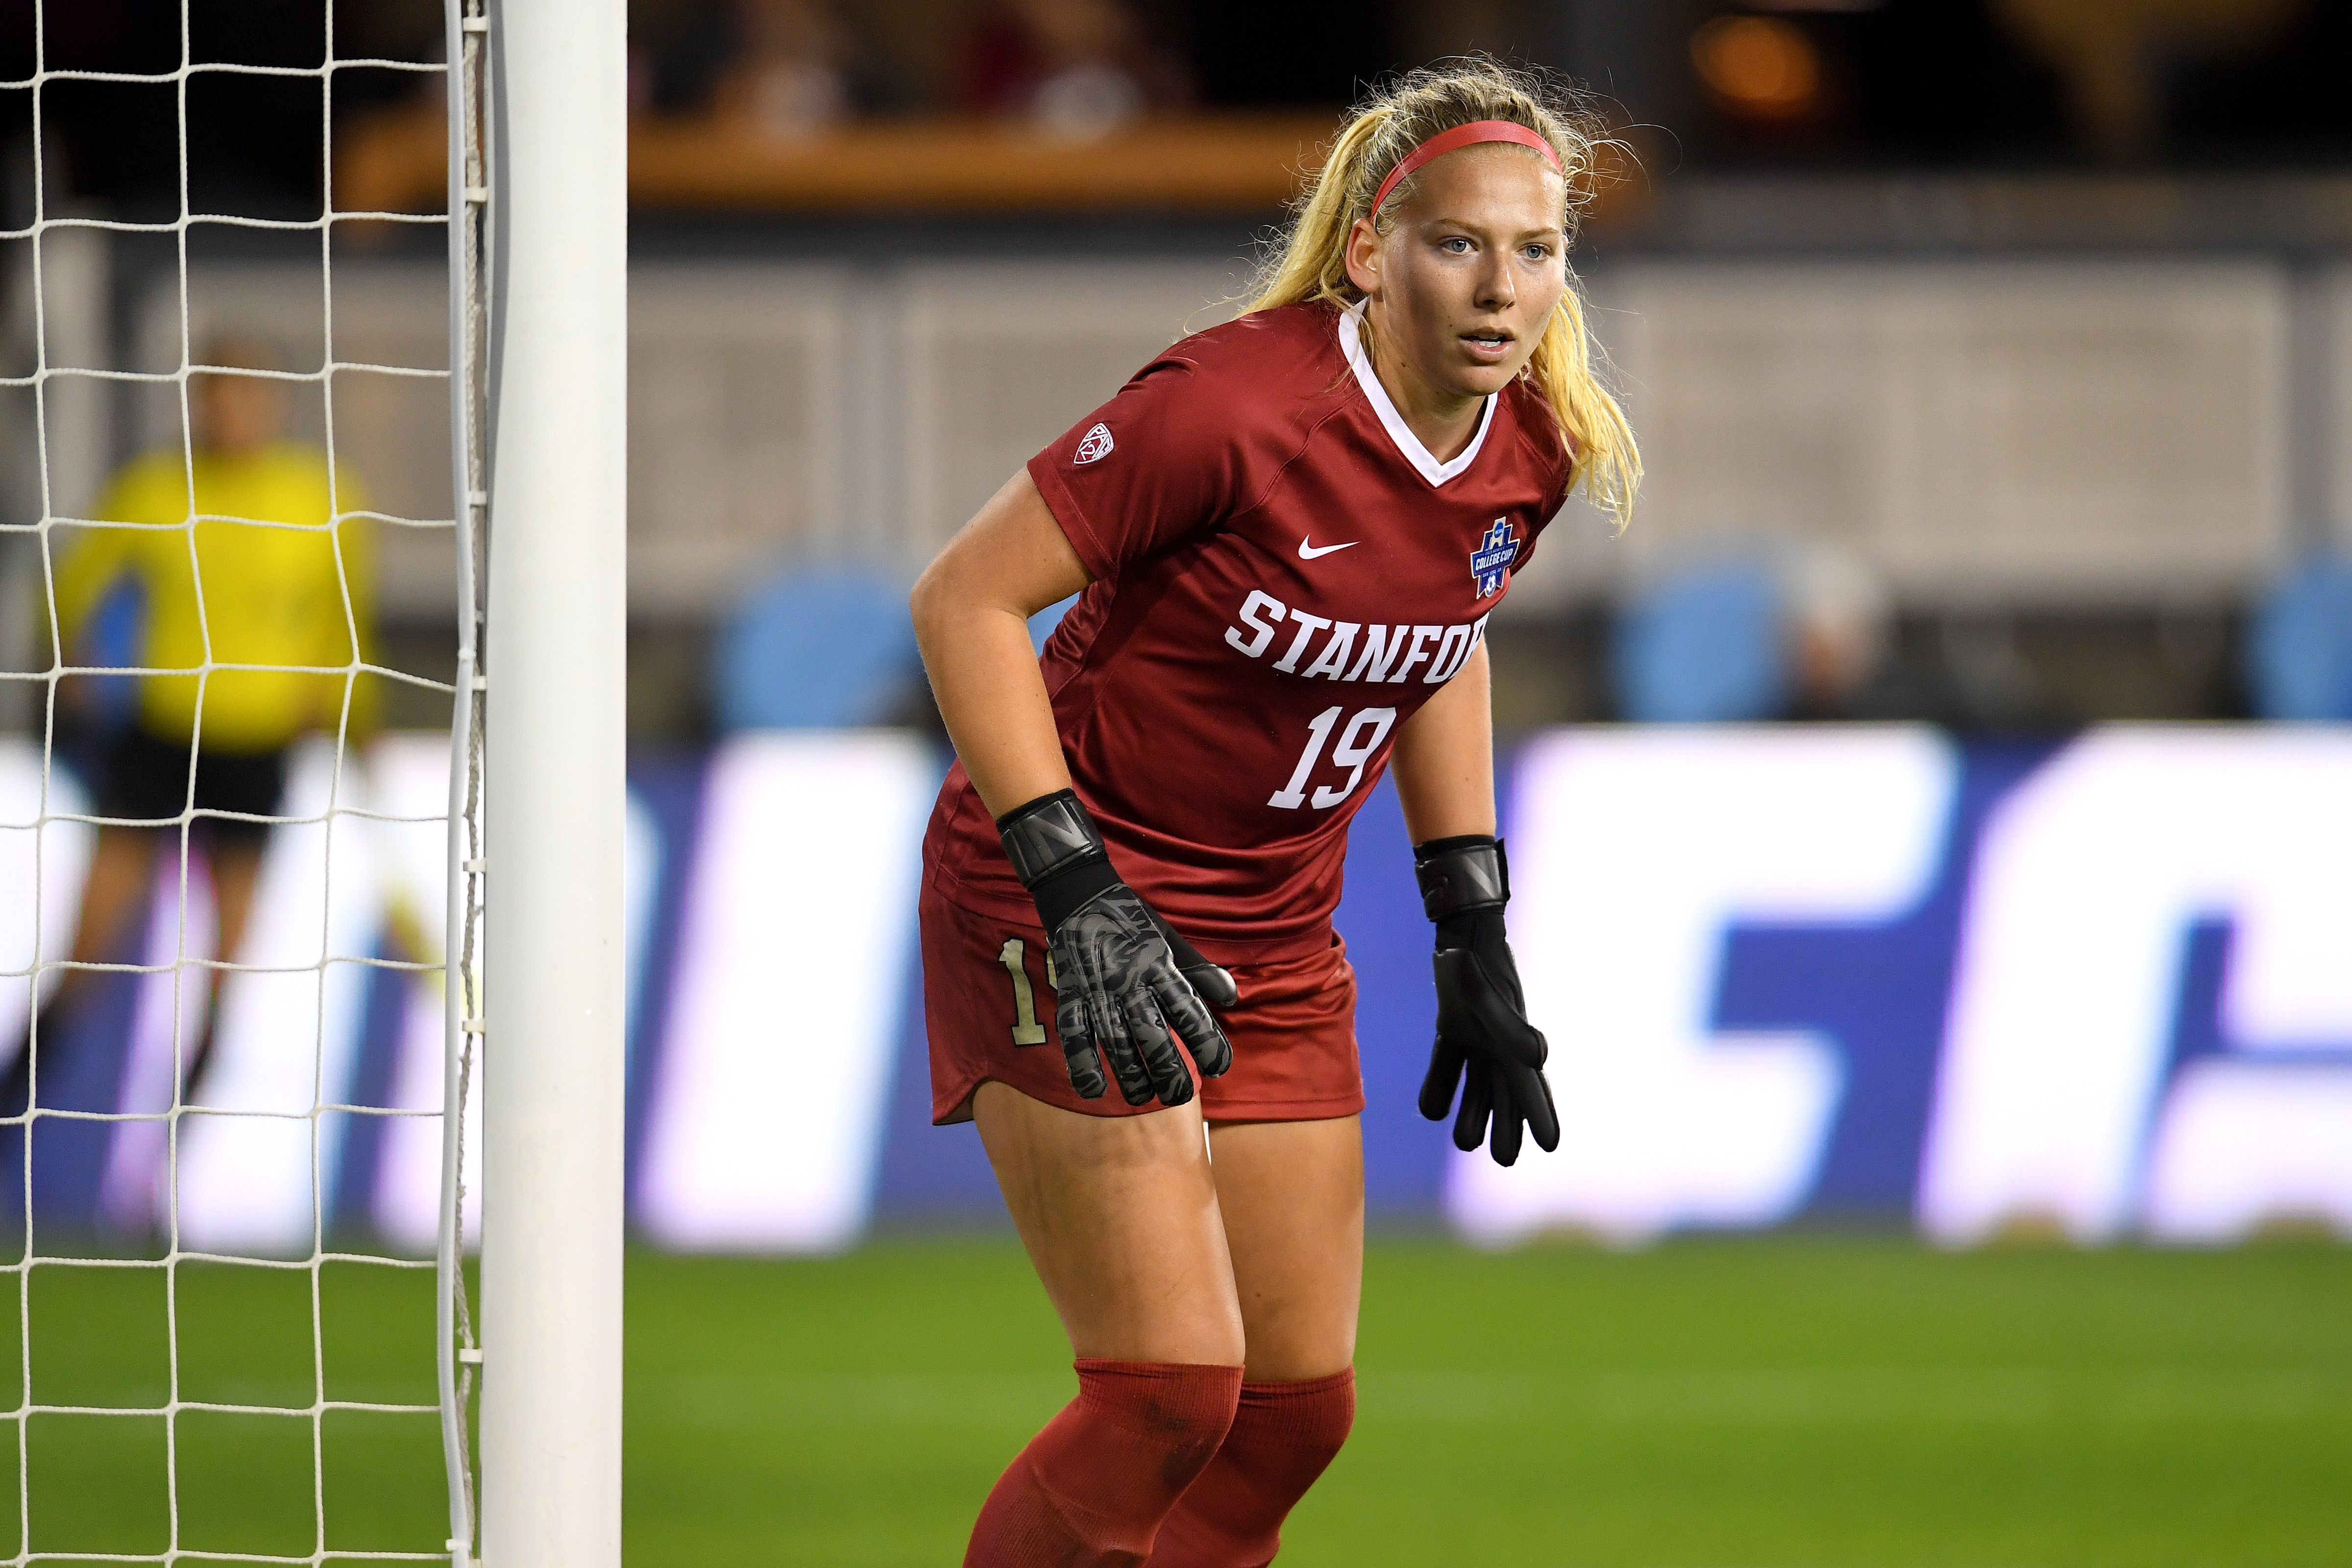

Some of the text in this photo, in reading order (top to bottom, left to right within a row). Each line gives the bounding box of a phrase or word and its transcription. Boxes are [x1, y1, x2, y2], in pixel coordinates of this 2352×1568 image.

[1475, 548, 1514, 571] COLLEGE CUP
[1267, 706, 1396, 809] 19
[999, 937, 1058, 1047] 1
